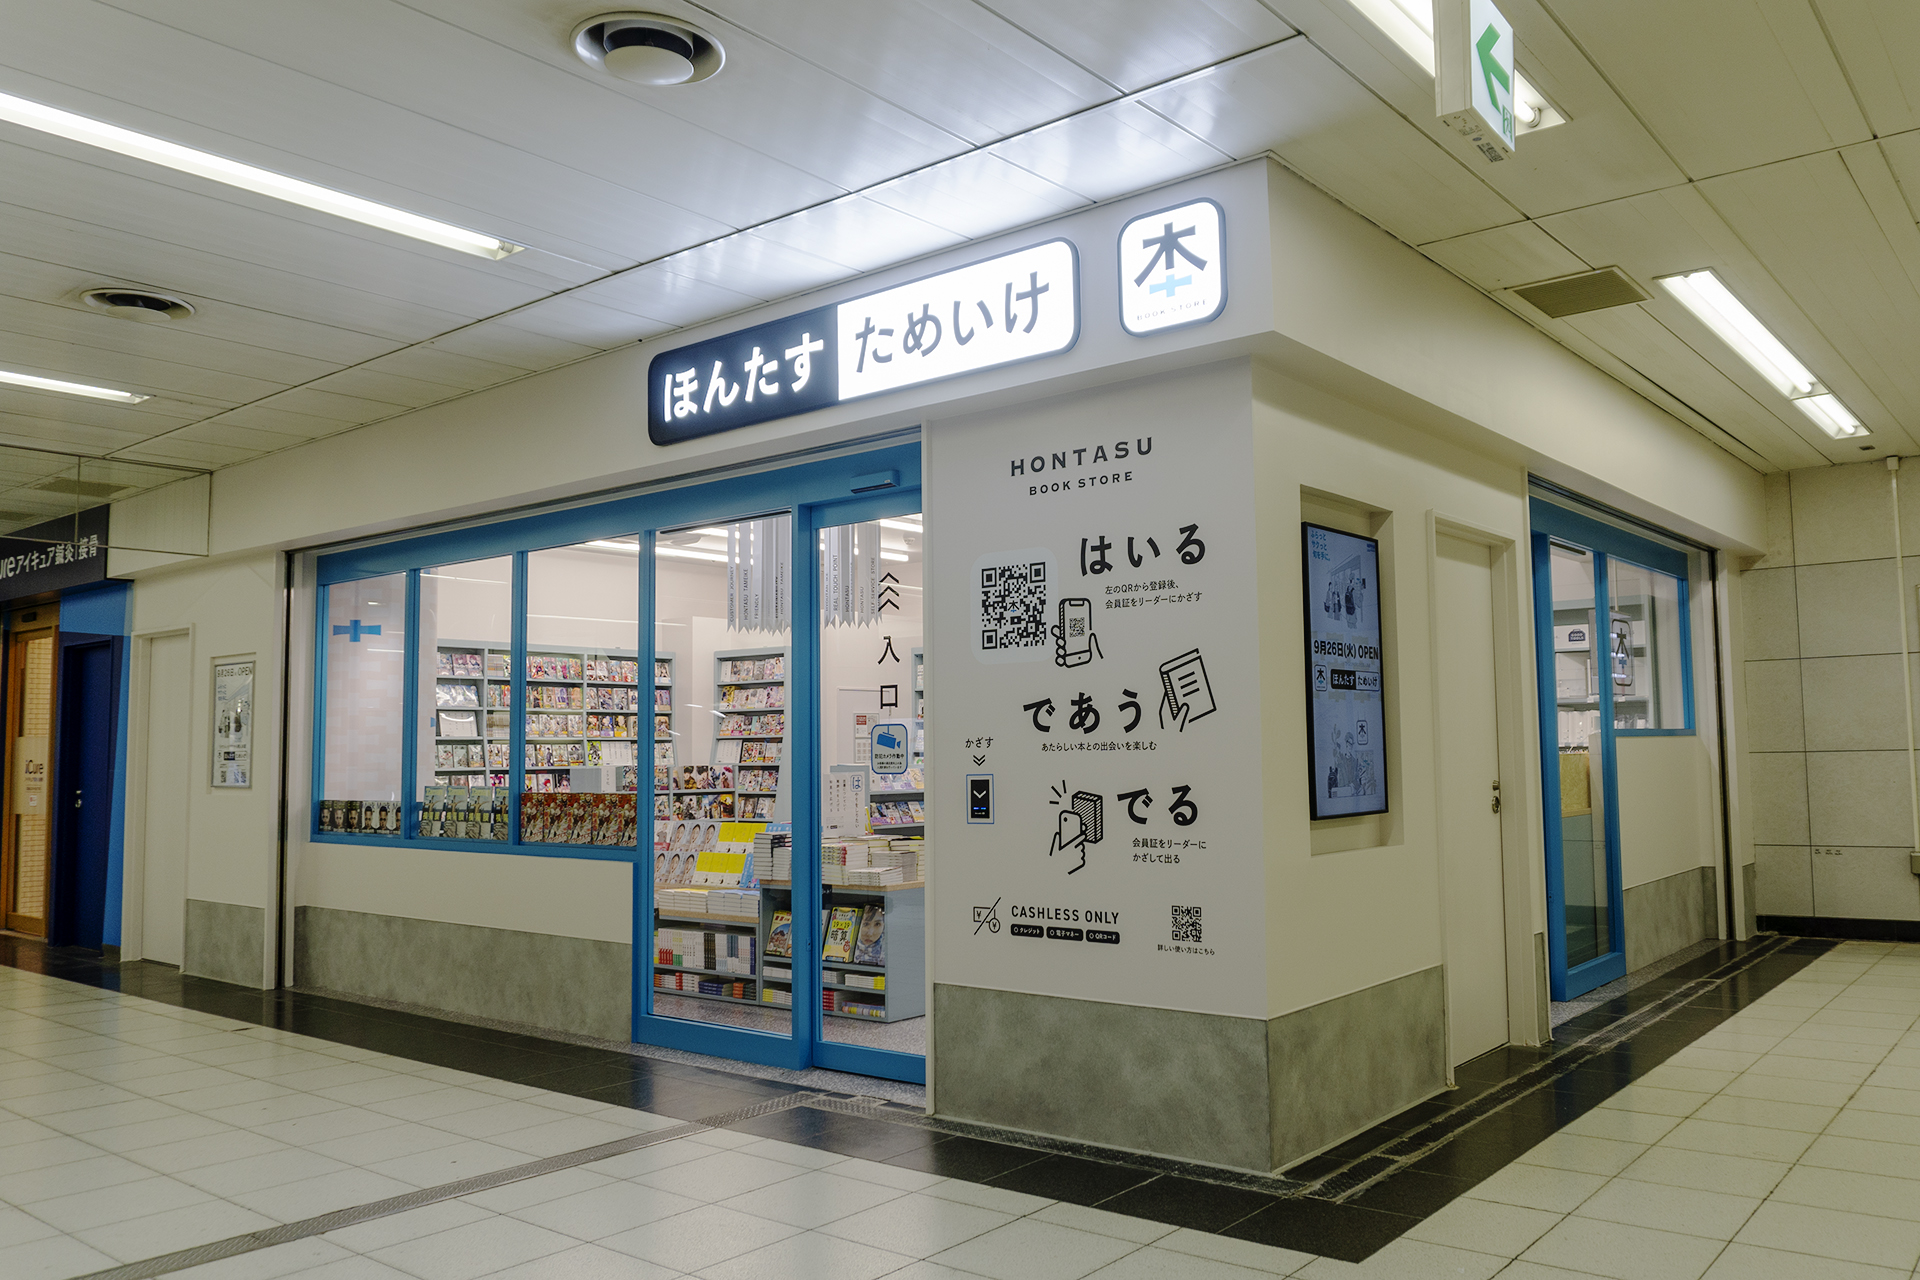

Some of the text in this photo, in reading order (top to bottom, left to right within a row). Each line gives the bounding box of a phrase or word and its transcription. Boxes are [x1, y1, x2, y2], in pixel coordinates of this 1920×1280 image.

[662, 271, 1050, 422] ほんたす ためいけ
[1010, 436, 1153, 477] HONTASU
[1029, 471, 1134, 496] BOOK STORE
[1079, 523, 1206, 577] はいる
[1104, 579, 1180, 595] 左のQRから登録後、
[1104, 592, 1203, 610] 会員証をリーダーにかざす
[1313, 639, 1379, 660] 9月26日(火) OPEN
[877, 636, 900, 710] 入口
[1023, 688, 1142, 734] であう
[965, 737, 994, 749] かざす
[1041, 741, 1158, 752] あたらしい本との出会いを楽しむ
[25, 759, 44, 774] iCure
[1116, 784, 1199, 827] でる
[1132, 838, 1207, 850] 会員証をリーダーに
[1132, 853, 1181, 864] かざして出る
[1011, 905, 1120, 925] CASHLESS ONLY
[1157, 943, 1216, 956] 詳しい使い方はこちら
